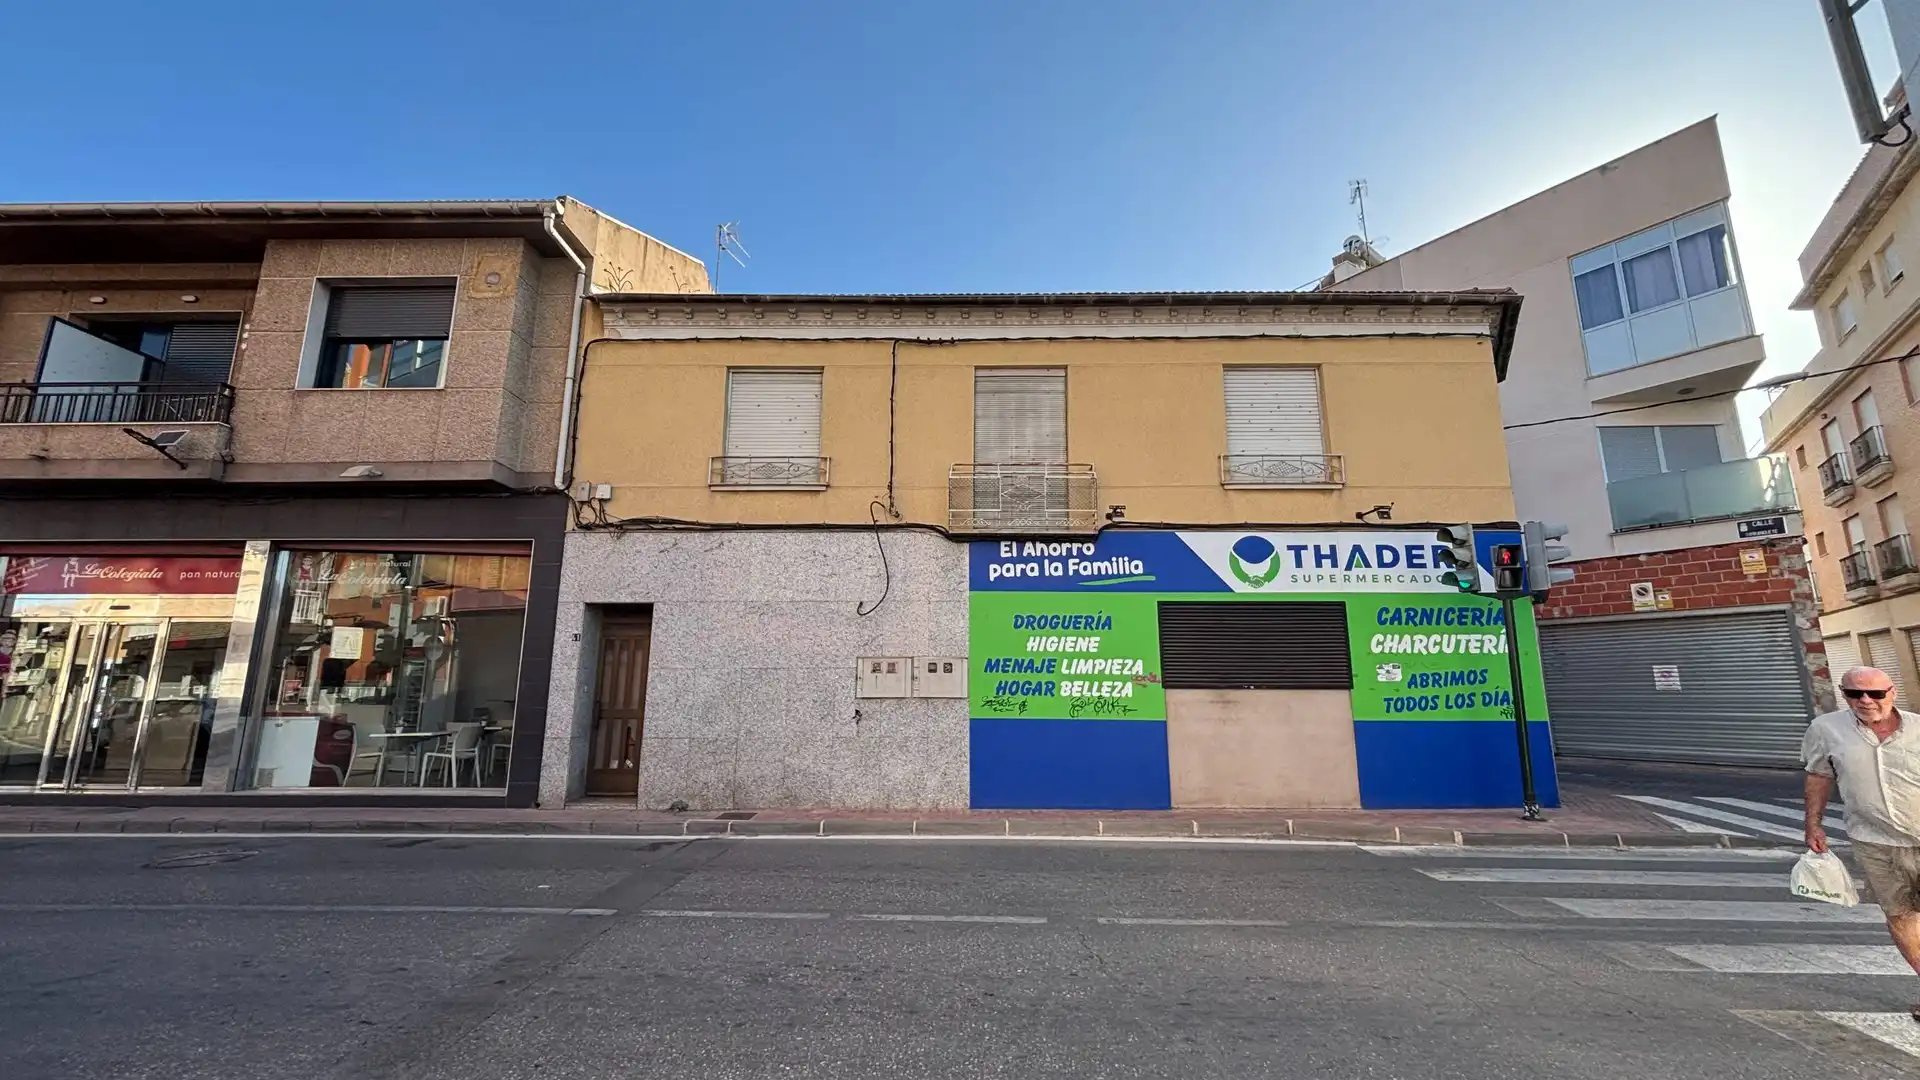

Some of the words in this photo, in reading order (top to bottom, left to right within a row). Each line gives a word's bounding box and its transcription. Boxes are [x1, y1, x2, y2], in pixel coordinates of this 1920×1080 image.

[1000, 541, 1017, 558] El
[1023, 541, 1095, 557] Ahorro
[100, 565, 164, 582] Colegiala
[180, 570, 200, 580] pan
[989, 562, 1039, 582] para
[1044, 559, 1063, 577] la
[1068, 556, 1144, 576] Familia
[1013, 610, 1112, 631] DROGUERÍA
[1376, 600, 1506, 628] CARNICERÍA
[1026, 636, 1101, 652] HIGIENE
[1370, 628, 1508, 655] CHARCUTERÍ
[984, 658, 1057, 674] MENAJE
[1061, 658, 1144, 675] LIMPIEZA
[995, 680, 1056, 697] HOGAR
[1060, 680, 1133, 697] BELLEZA
[1407, 668, 1488, 689] ABRIMOS
[1383, 694, 1440, 713] TODOS
[1444, 692, 1476, 709] LOS
[1480, 684, 1514, 708] DÍA
